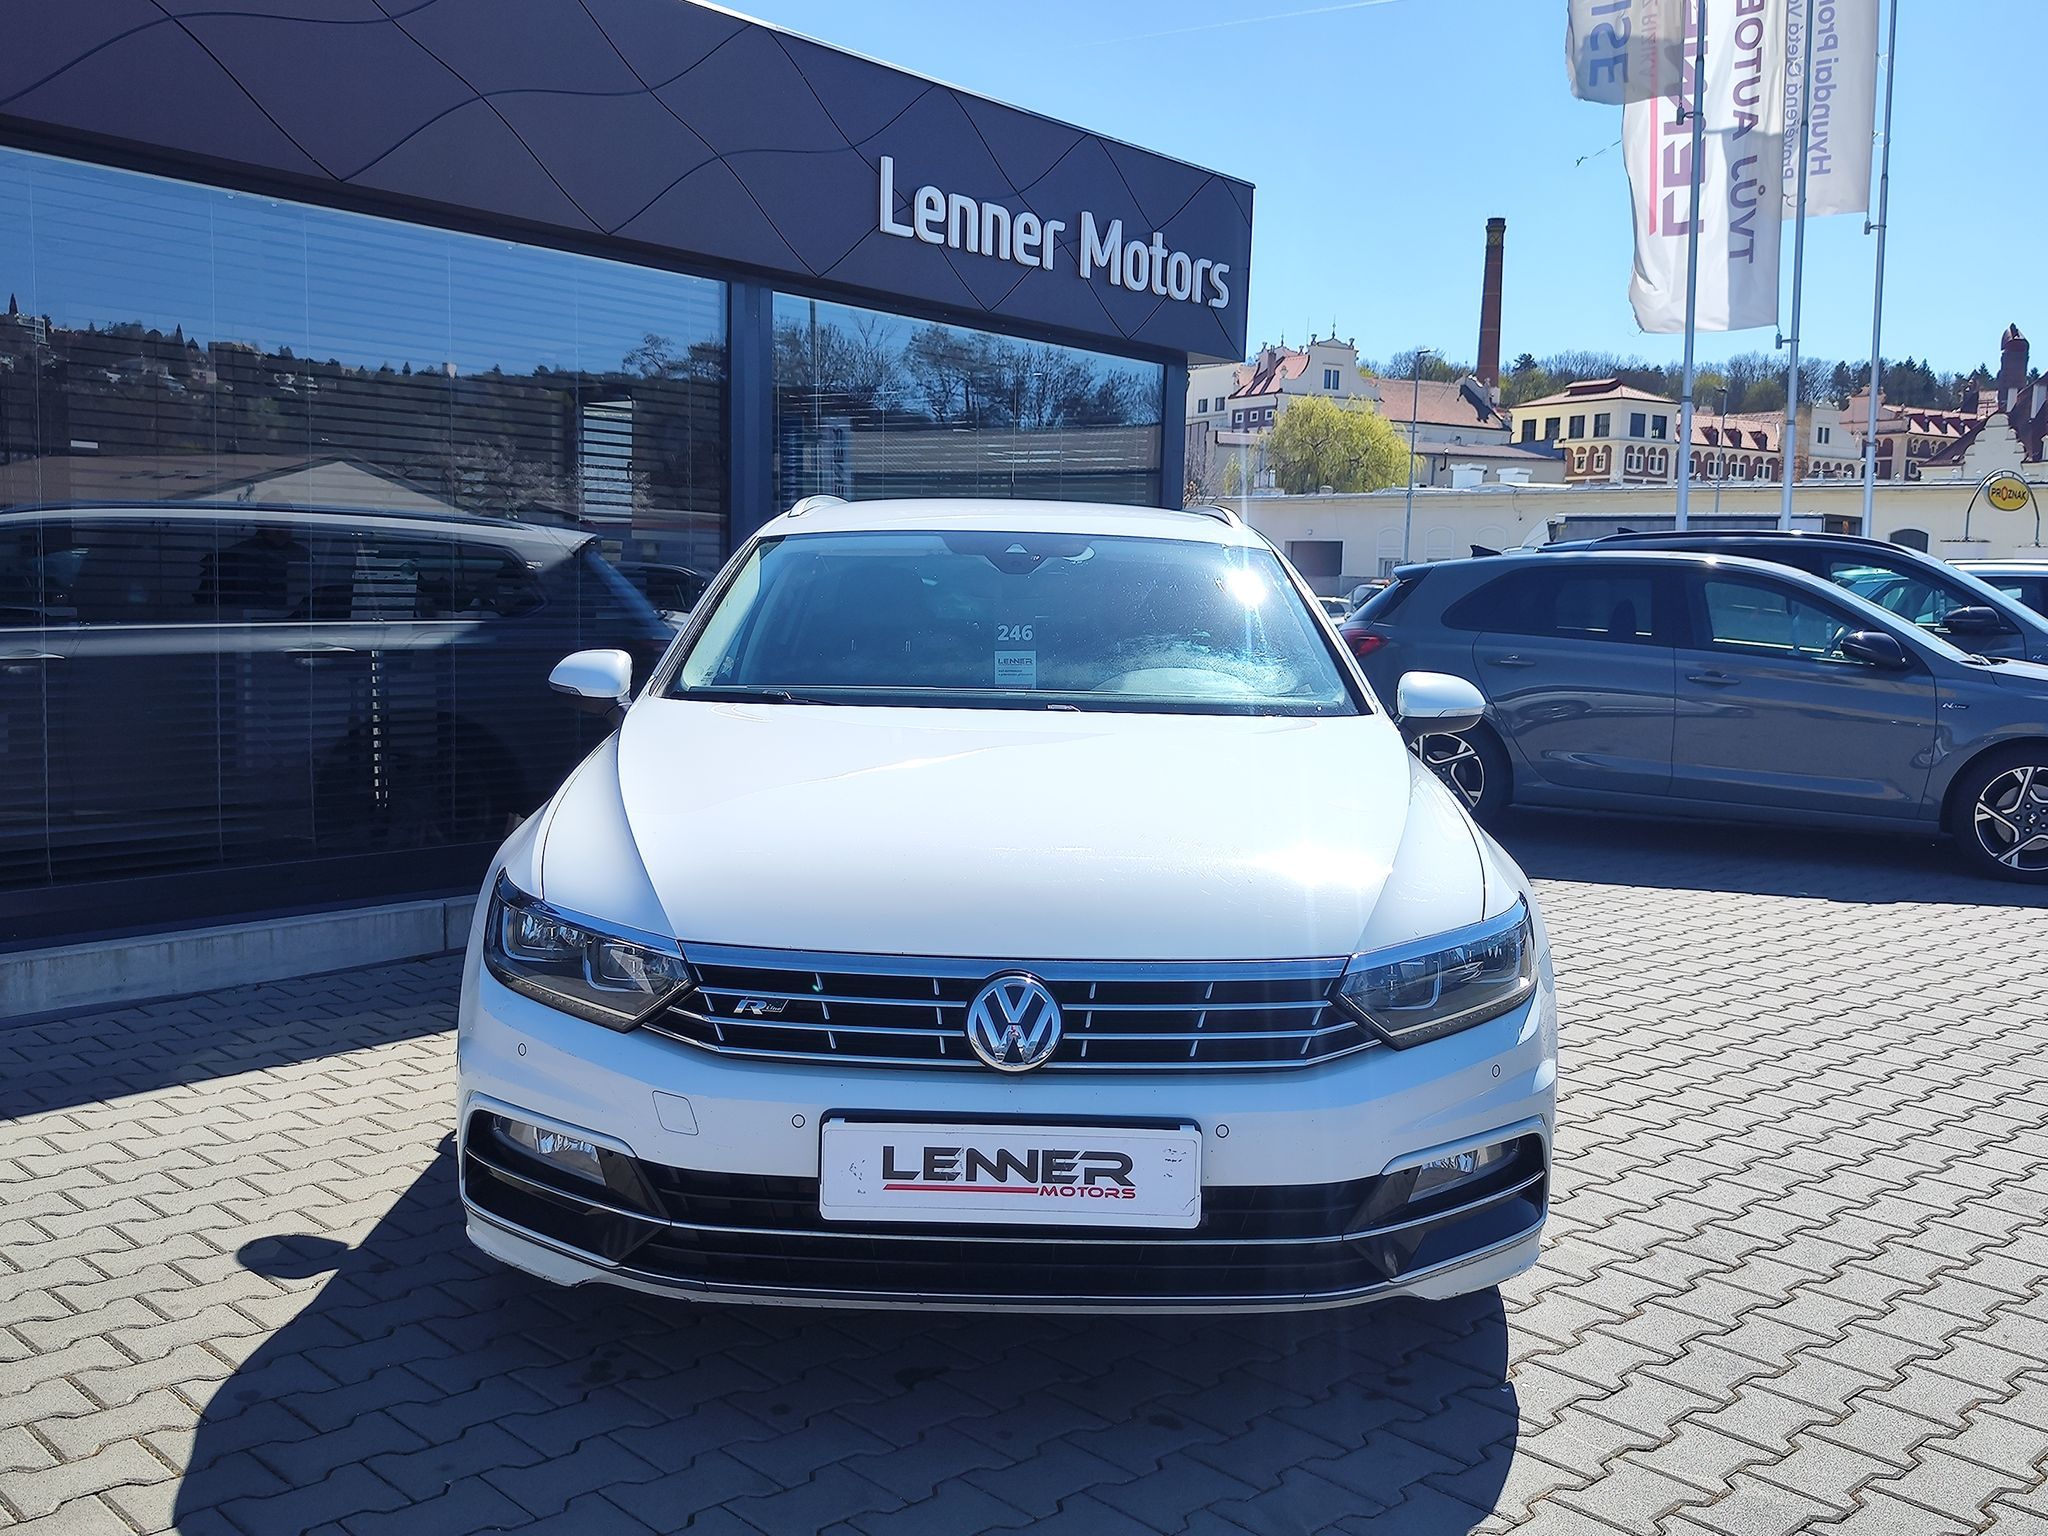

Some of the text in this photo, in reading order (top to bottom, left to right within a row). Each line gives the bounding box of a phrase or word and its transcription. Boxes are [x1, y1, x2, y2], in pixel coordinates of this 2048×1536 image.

[879, 155, 1231, 309] Lenner Motors
[997, 624, 1033, 641] 246
[882, 1145, 1136, 1187] LENNER
[1038, 1185, 1136, 1200] MOTORS
